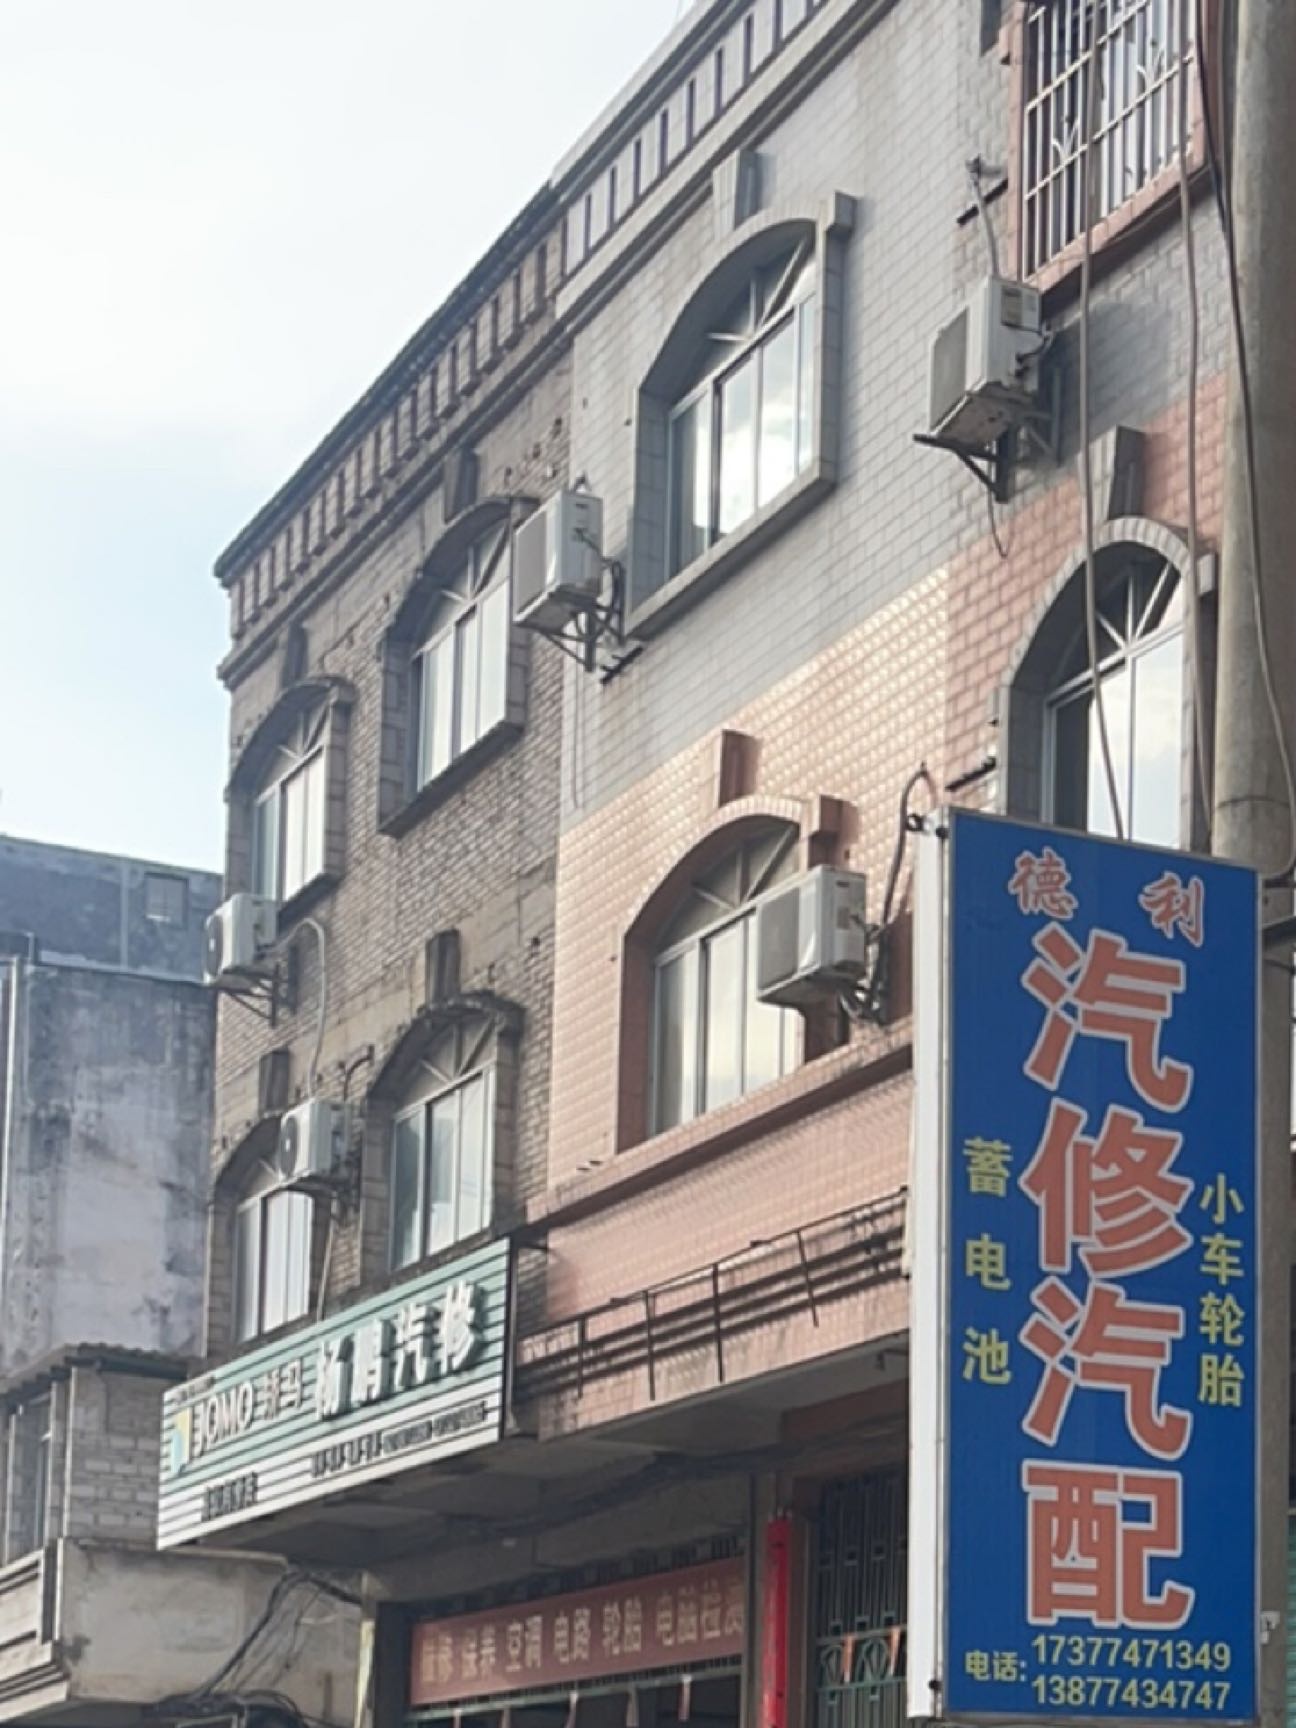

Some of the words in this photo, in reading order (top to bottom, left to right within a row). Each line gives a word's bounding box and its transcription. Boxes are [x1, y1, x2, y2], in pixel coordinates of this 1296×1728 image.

[1008, 847, 1205, 947] 德利
[962, 1136, 1013, 1385] 蓄电池
[1019, 921, 1196, 1630] 汽修汽配
[1198, 1173, 1245, 1407] 小车轮胎
[964, 1649, 1027, 1683] 电话:
[1032, 1635, 1231, 1671] 17377471349
[1032, 1677, 1231, 1711] 13877434747
